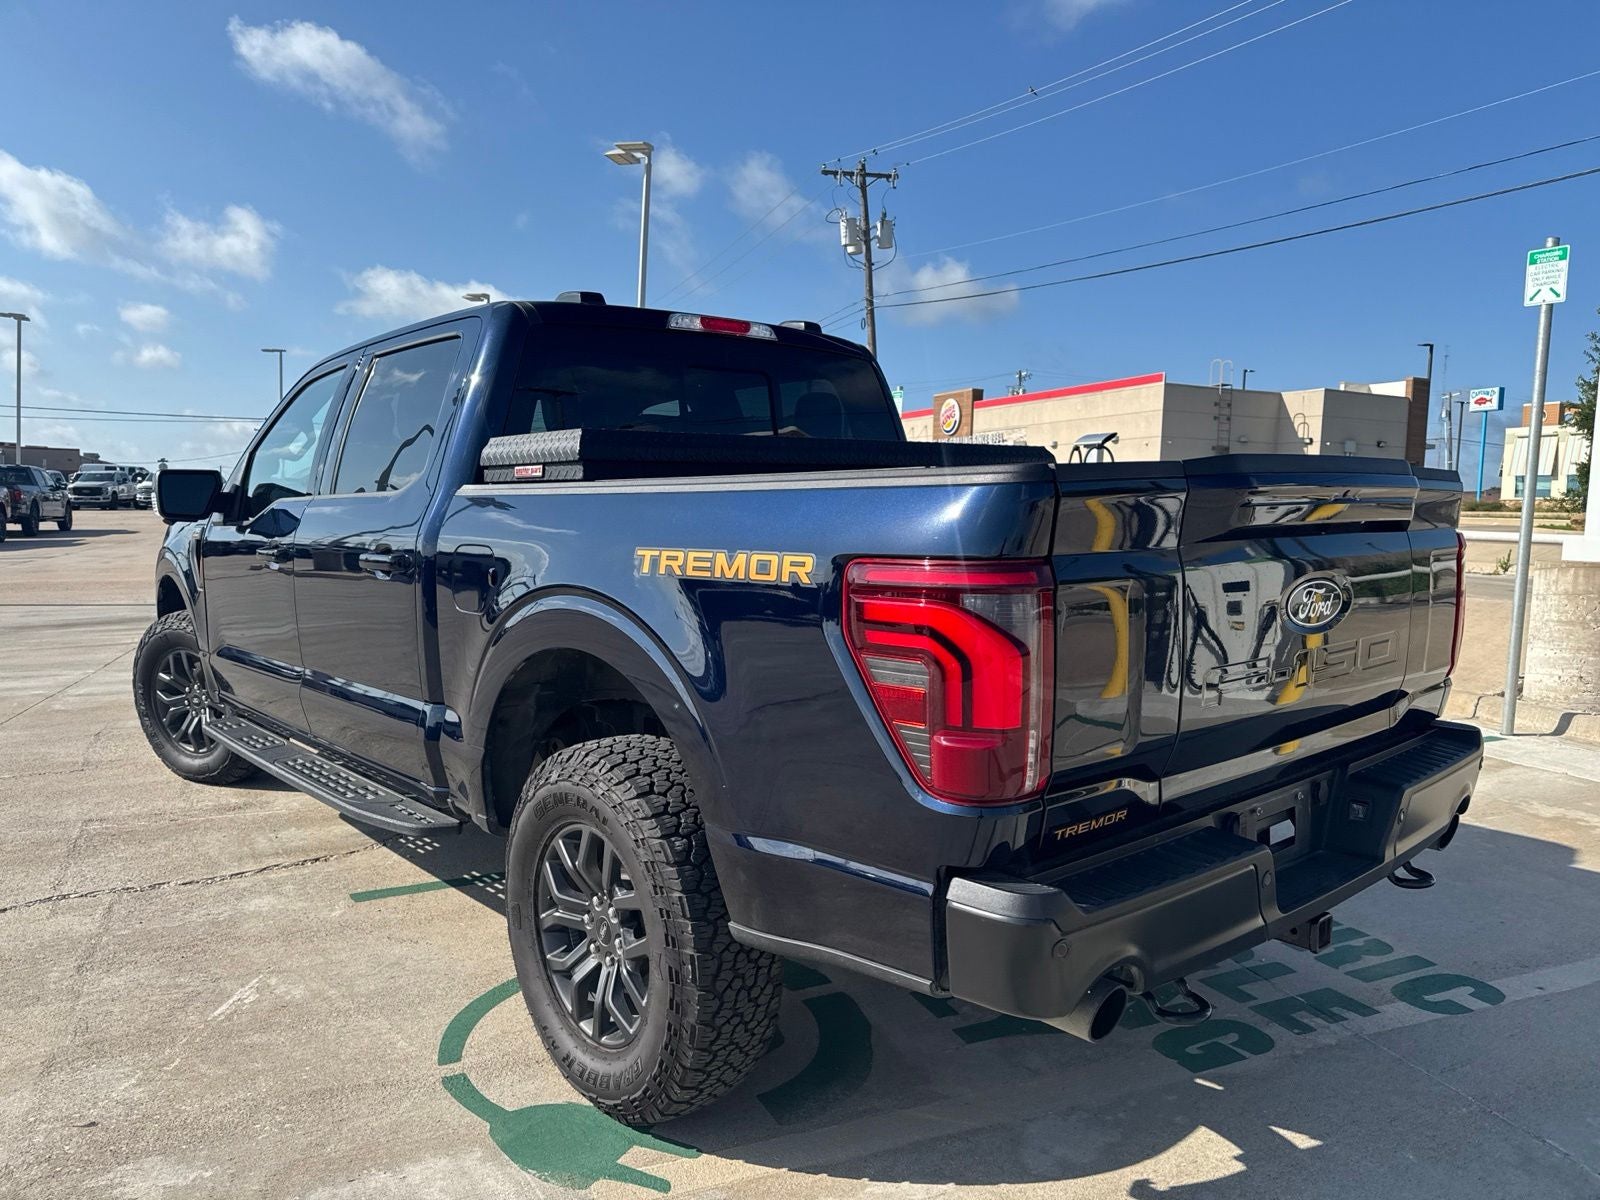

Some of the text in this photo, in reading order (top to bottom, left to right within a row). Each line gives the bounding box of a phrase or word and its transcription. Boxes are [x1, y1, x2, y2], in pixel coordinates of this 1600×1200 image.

[634, 547, 816, 588] TREMOR
[1299, 588, 1334, 619] Ford
[1054, 809, 1127, 840] TREMOR
[560, 1053, 643, 1091] GRABBER
